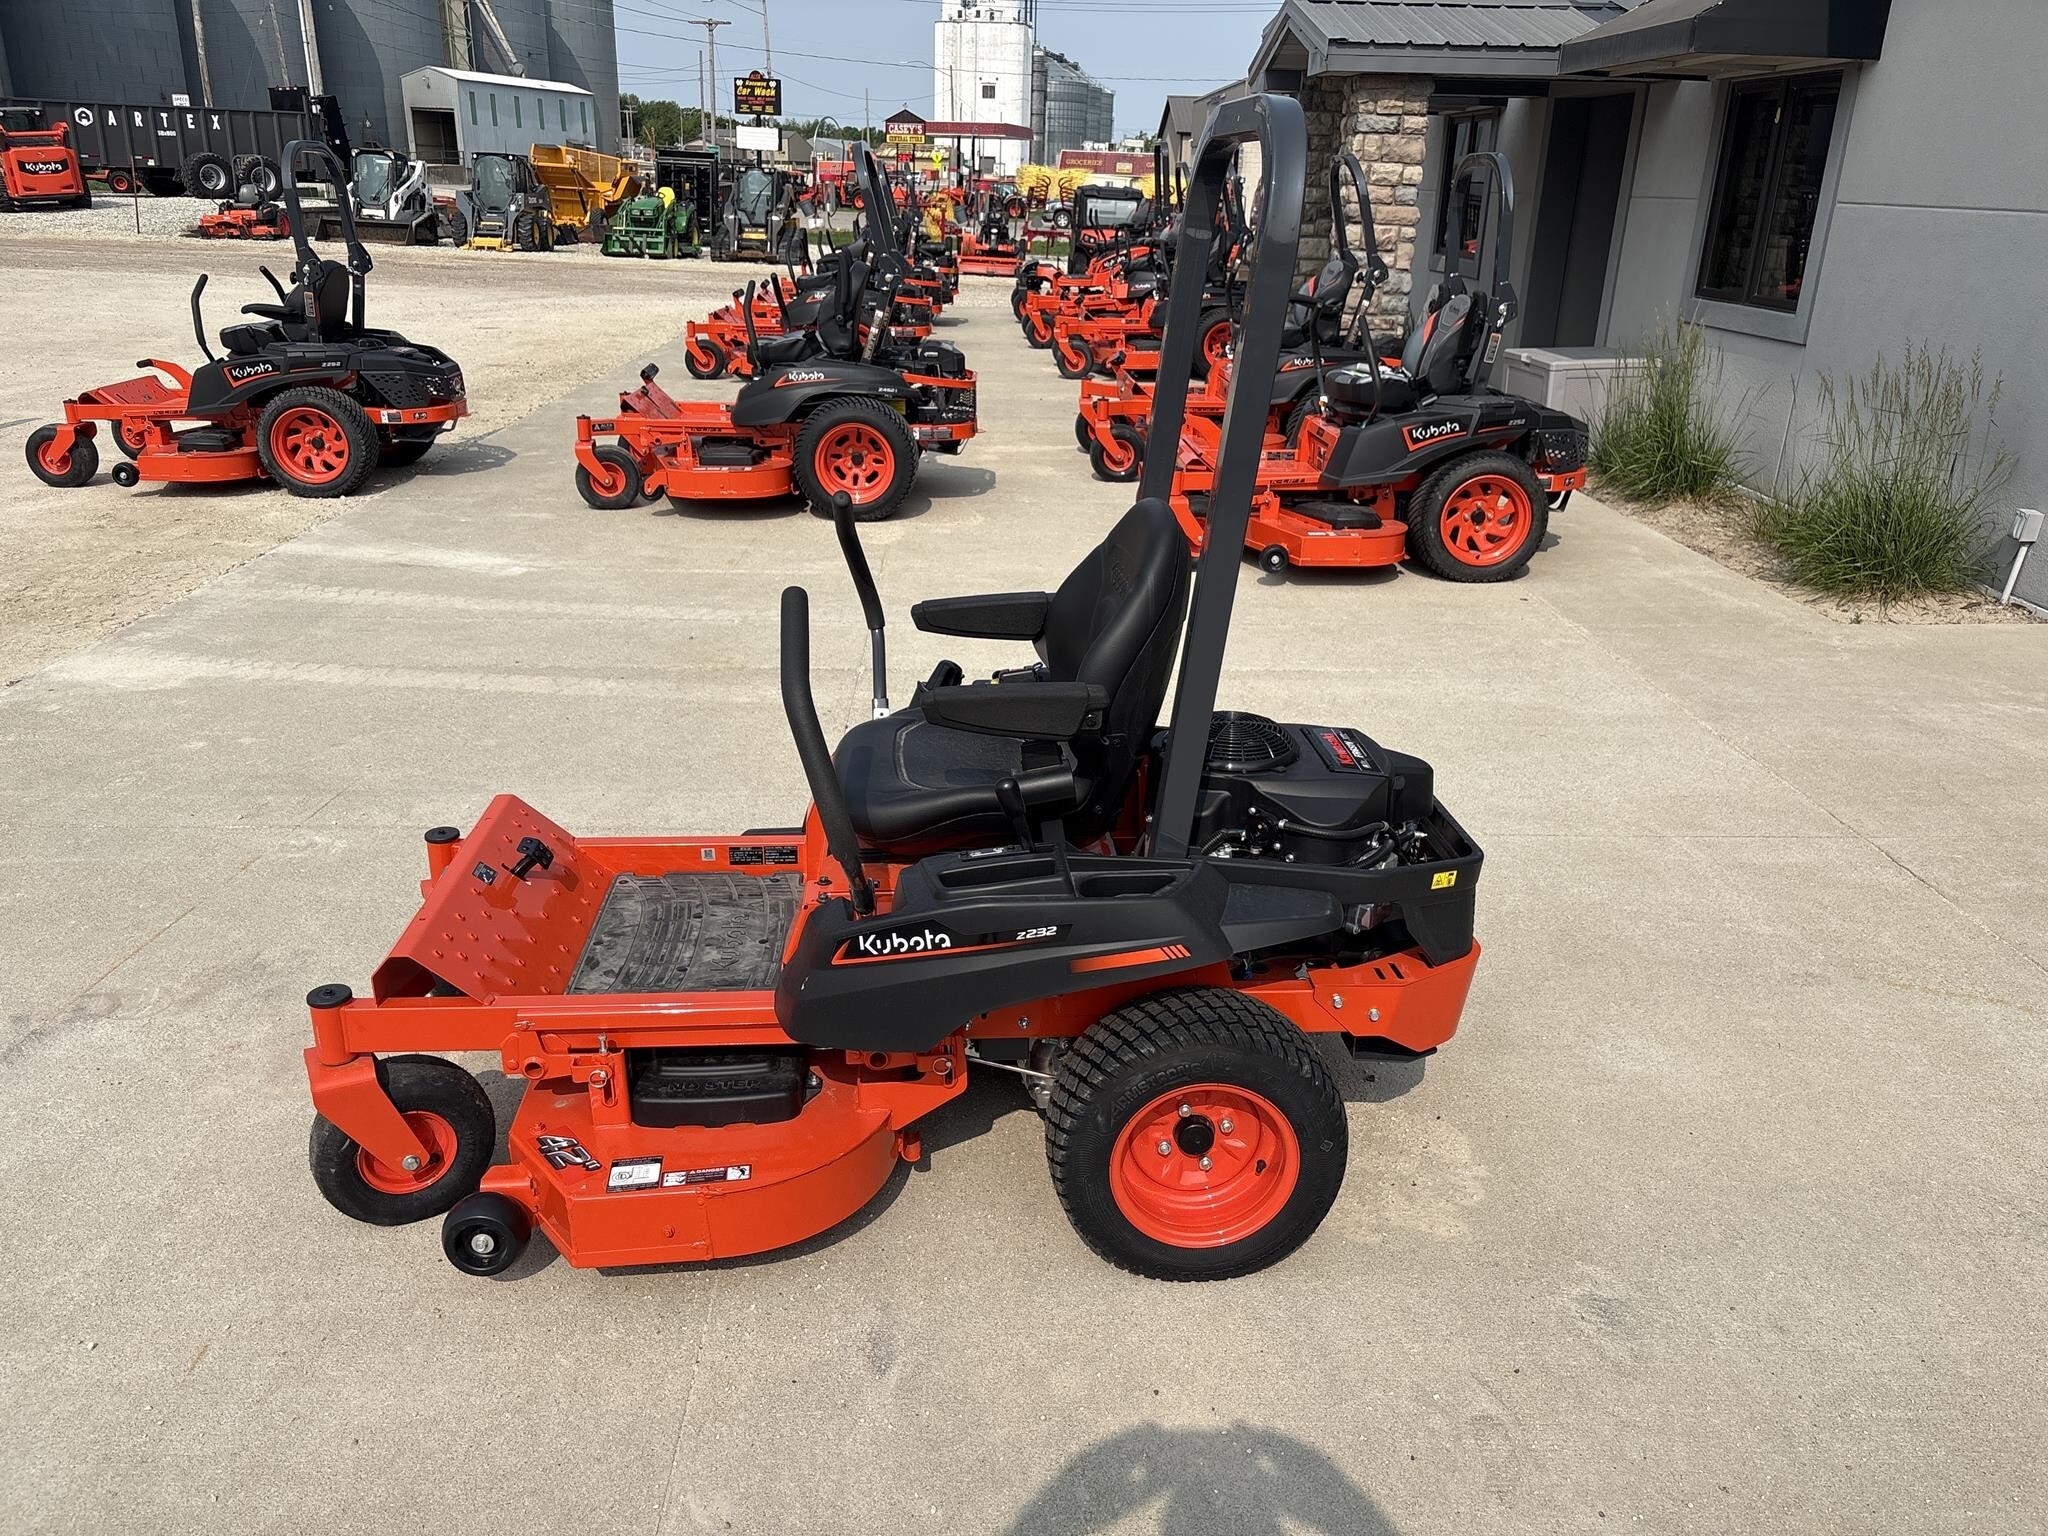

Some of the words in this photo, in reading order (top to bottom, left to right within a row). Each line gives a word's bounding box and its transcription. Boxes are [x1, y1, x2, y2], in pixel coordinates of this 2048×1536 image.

[737, 86, 751, 95] Car
[754, 87, 776, 97] Wash
[888, 124, 923, 134] CASEY'S
[25, 162, 62, 171] Kubota
[231, 362, 273, 378] Kubota
[788, 370, 825, 381] Kubota
[1412, 421, 1460, 440] Kubota
[858, 929, 952, 955] Kubota
[702, 1079, 761, 1091] STEP
[536, 1135, 593, 1171] 42
